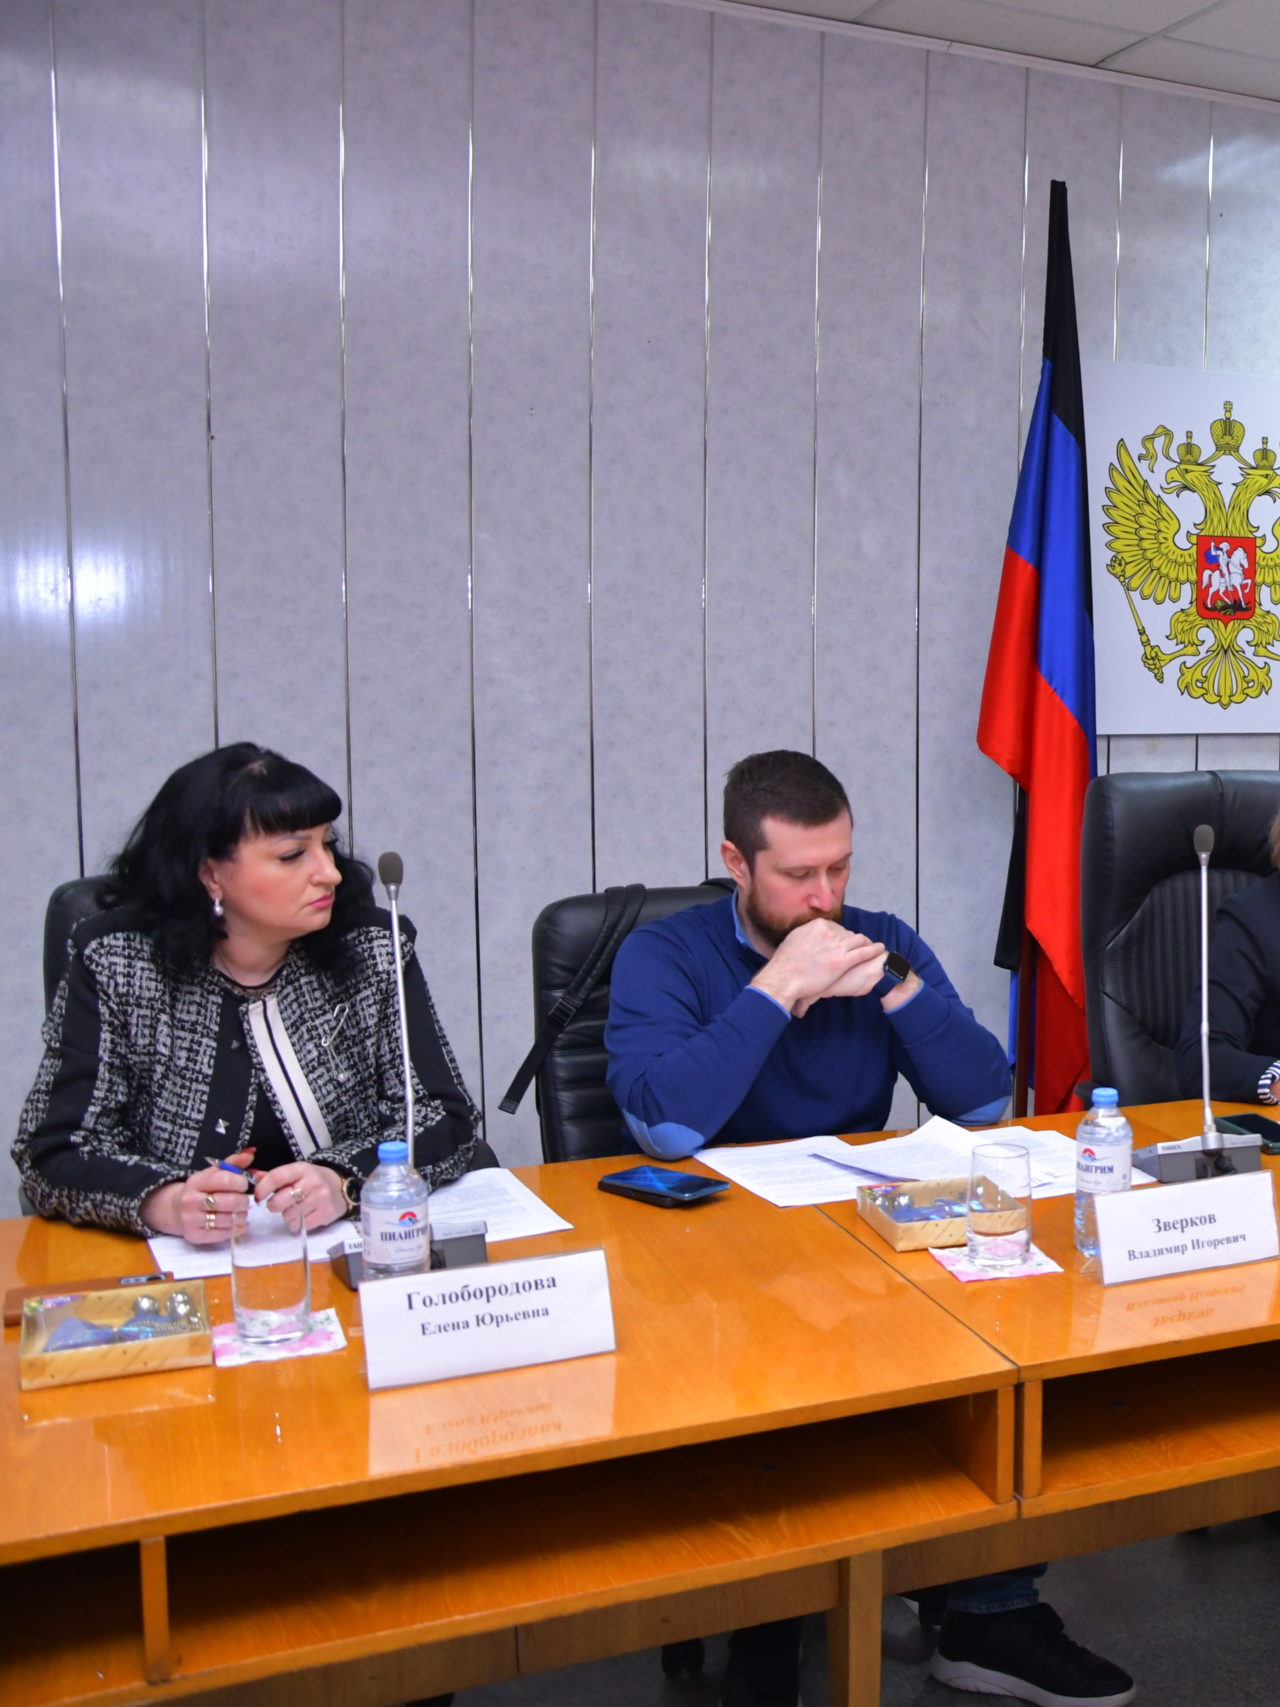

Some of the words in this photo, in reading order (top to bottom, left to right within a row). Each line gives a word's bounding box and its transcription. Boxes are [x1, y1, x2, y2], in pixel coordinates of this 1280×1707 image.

[1152, 1213, 1217, 1233] Зверков
[1127, 1243, 1188, 1261] Владимир
[1191, 1233, 1247, 1250] Игоревич
[407, 1276, 557, 1310] Голобородова
[421, 1319, 471, 1336] Елена
[475, 1306, 550, 1328] Юрьевна
